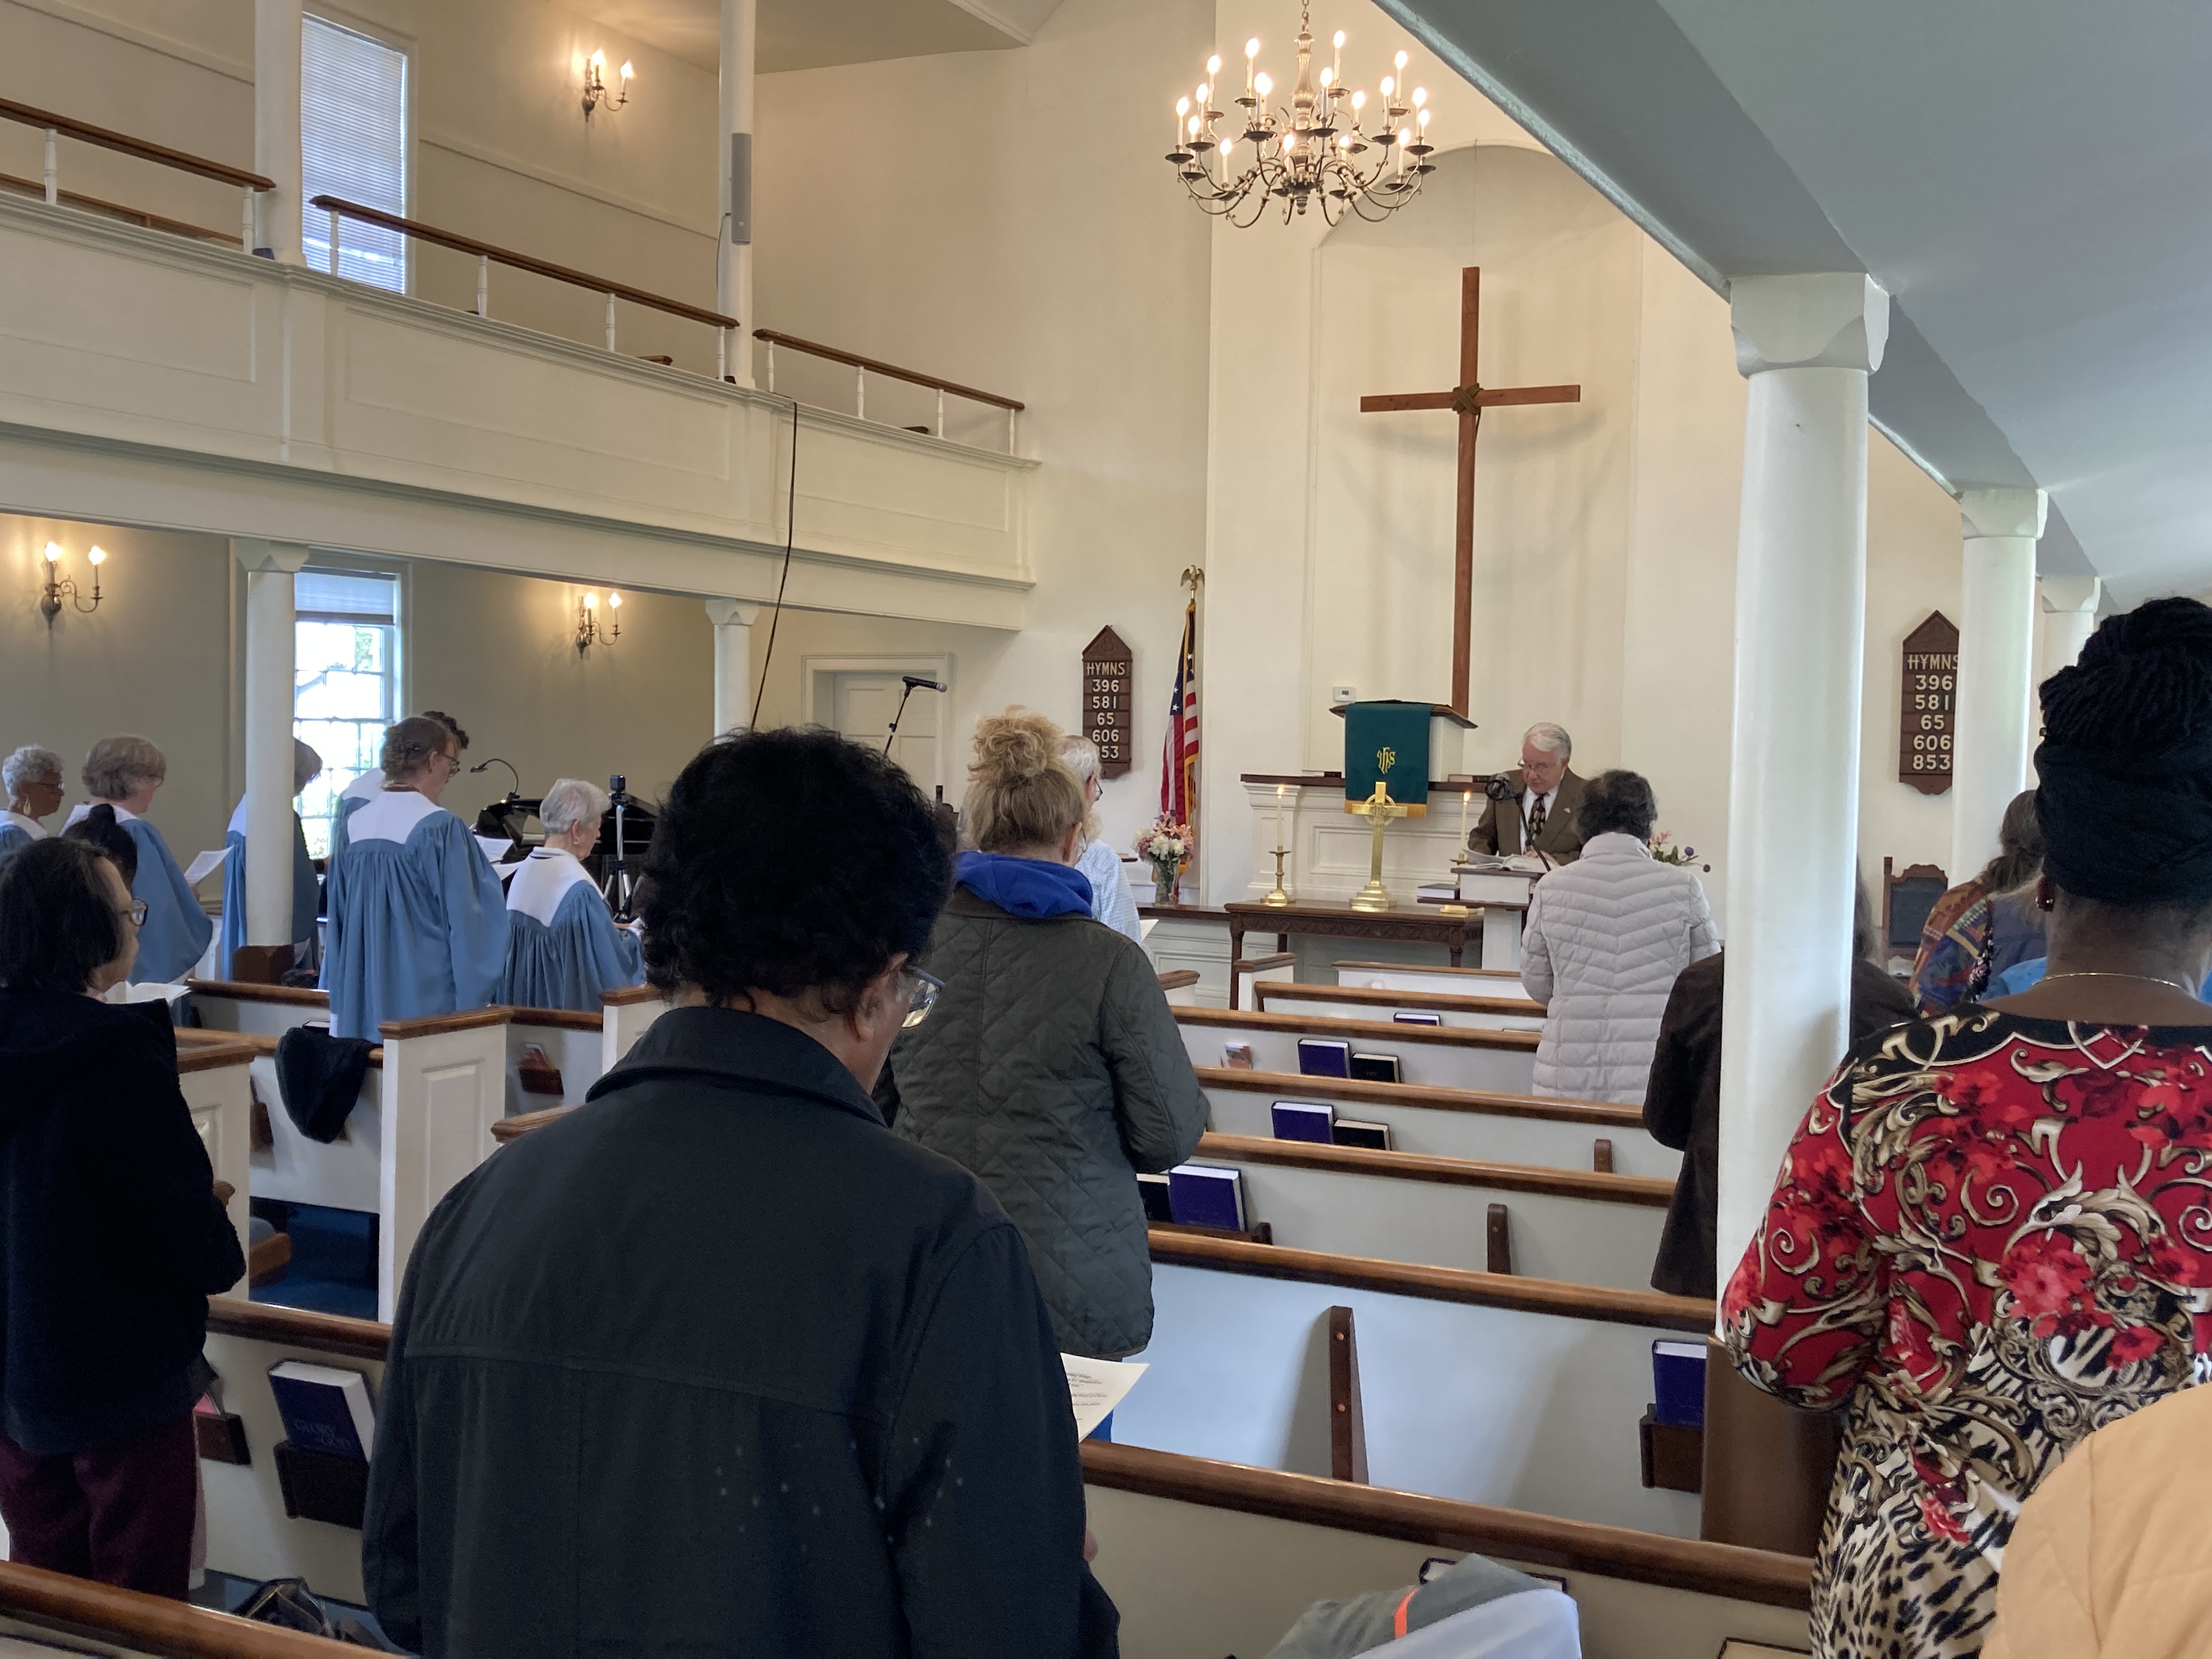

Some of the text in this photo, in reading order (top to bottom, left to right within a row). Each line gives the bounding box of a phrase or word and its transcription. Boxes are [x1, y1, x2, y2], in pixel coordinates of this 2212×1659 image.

[1086, 662, 1125, 675] HYMNS
[1908, 654, 1957, 669] HYMNS
[1092, 679, 1119, 692] 396
[1915, 675, 1953, 690] 396
[1092, 696, 1116, 709] 581
[1915, 695, 1949, 710] 581
[1097, 713, 1114, 725] 65
[1921, 715, 1944, 730] 65
[1092, 729, 1119, 742] 606
[1913, 735, 1951, 751] 606
[1097, 746, 1119, 759] 53
[1912, 754, 1950, 770] 853
